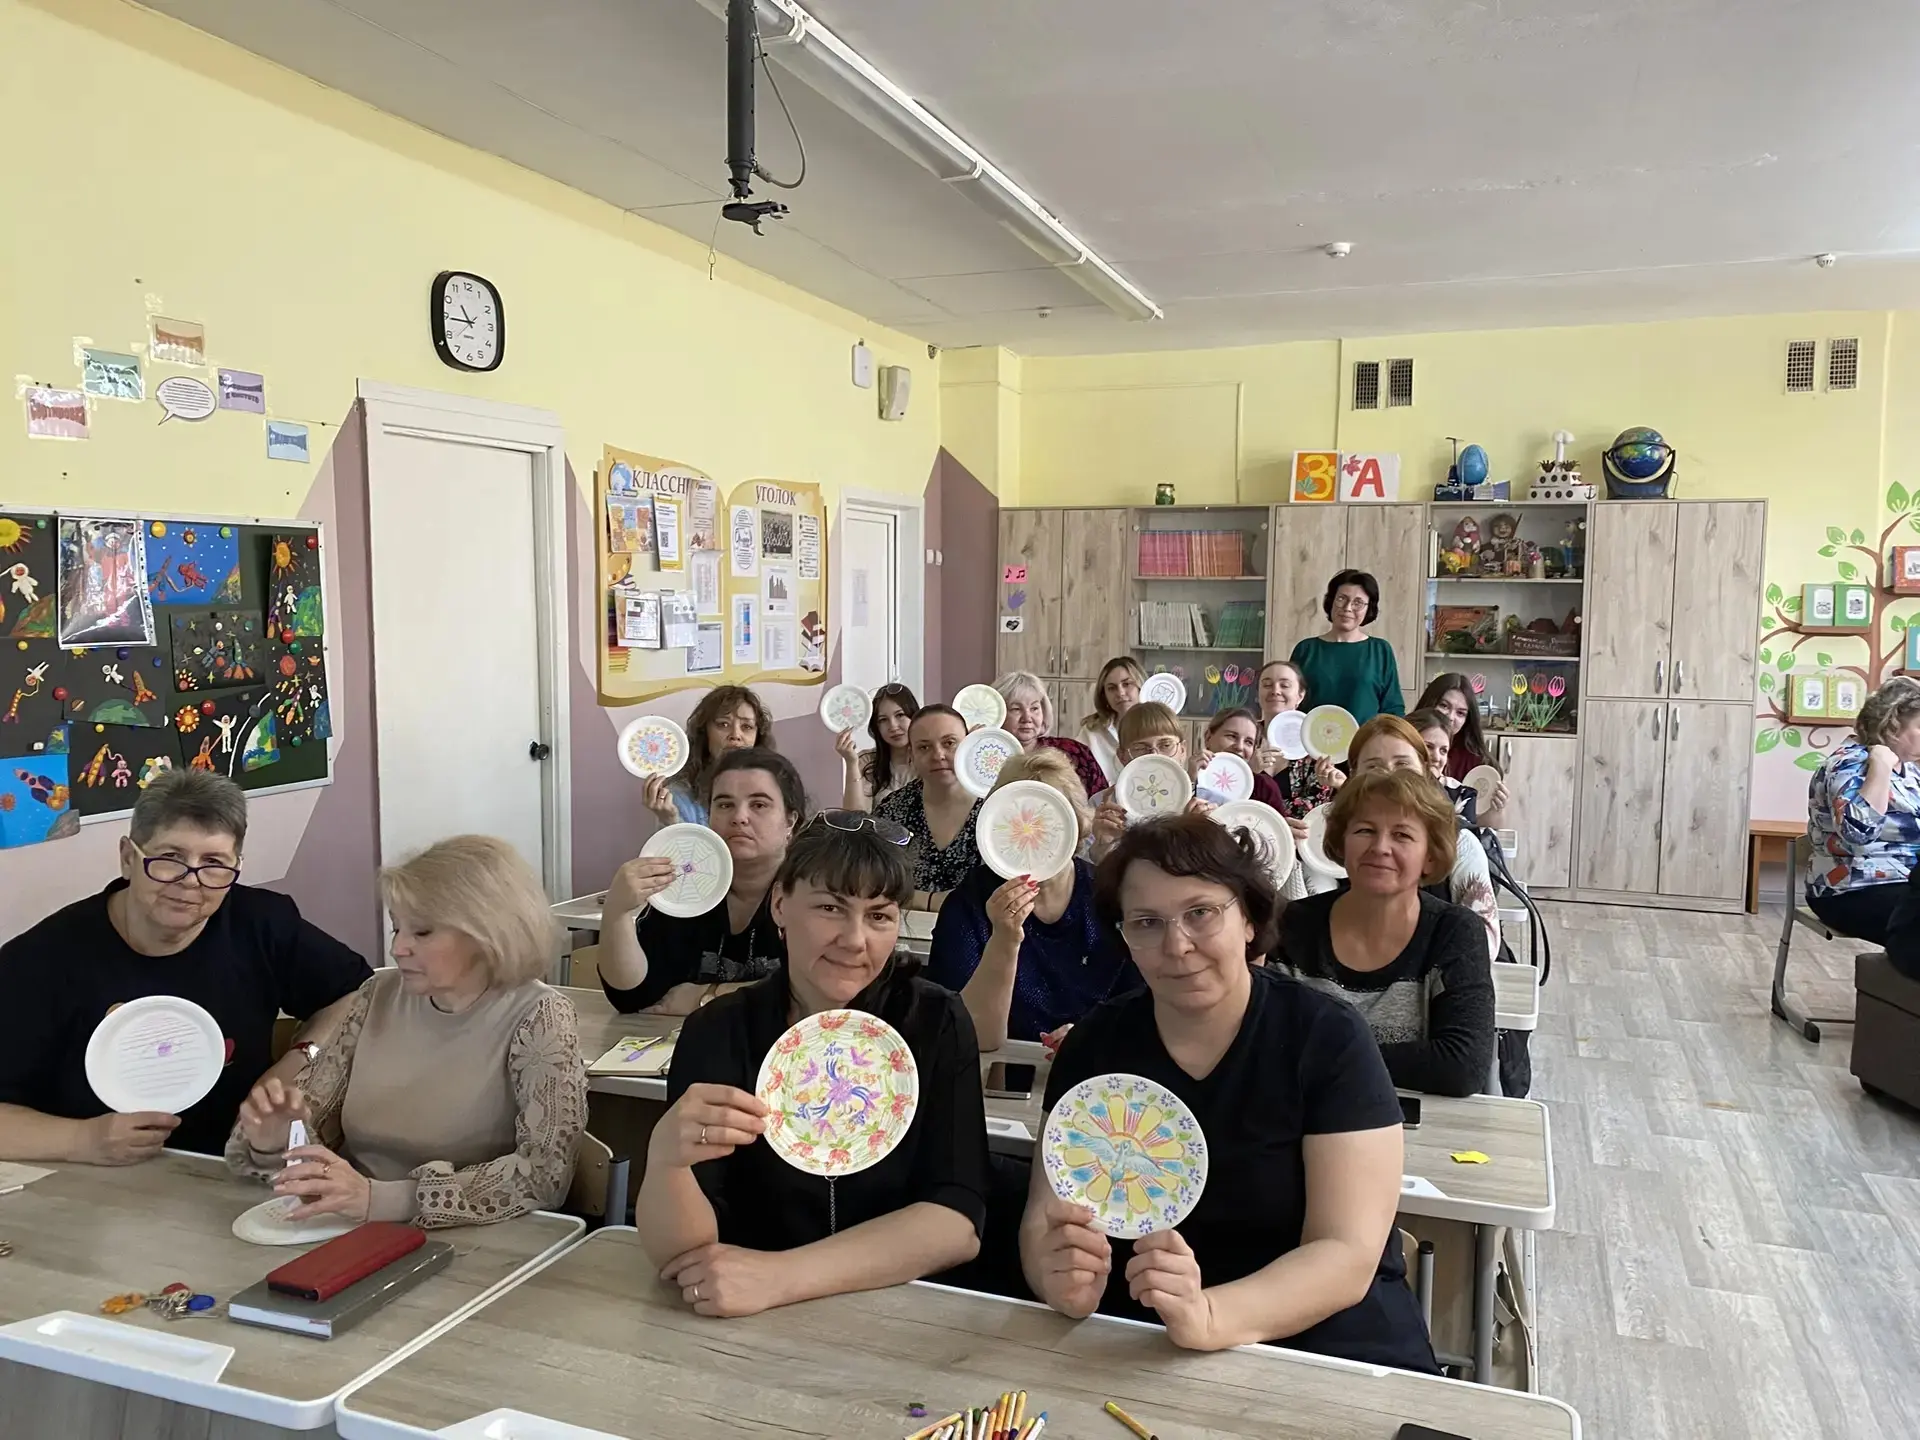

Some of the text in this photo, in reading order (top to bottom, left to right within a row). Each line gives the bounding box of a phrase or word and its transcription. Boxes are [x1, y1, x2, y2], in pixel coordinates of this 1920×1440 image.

[452, 284, 459, 293] 11
[463, 282, 473, 292] 12
[444, 295, 452, 304] 0
[477, 291, 481, 299] 1
[484, 305, 491, 314] 2
[487, 323, 494, 332] 3
[446, 330, 453, 339] 8
[454, 344, 461, 353] 7
[485, 340, 492, 348] 4
[466, 353, 473, 361] 6
[477, 350, 484, 359] 5
[1303, 454, 1333, 499] 3
[1350, 458, 1385, 498] А
